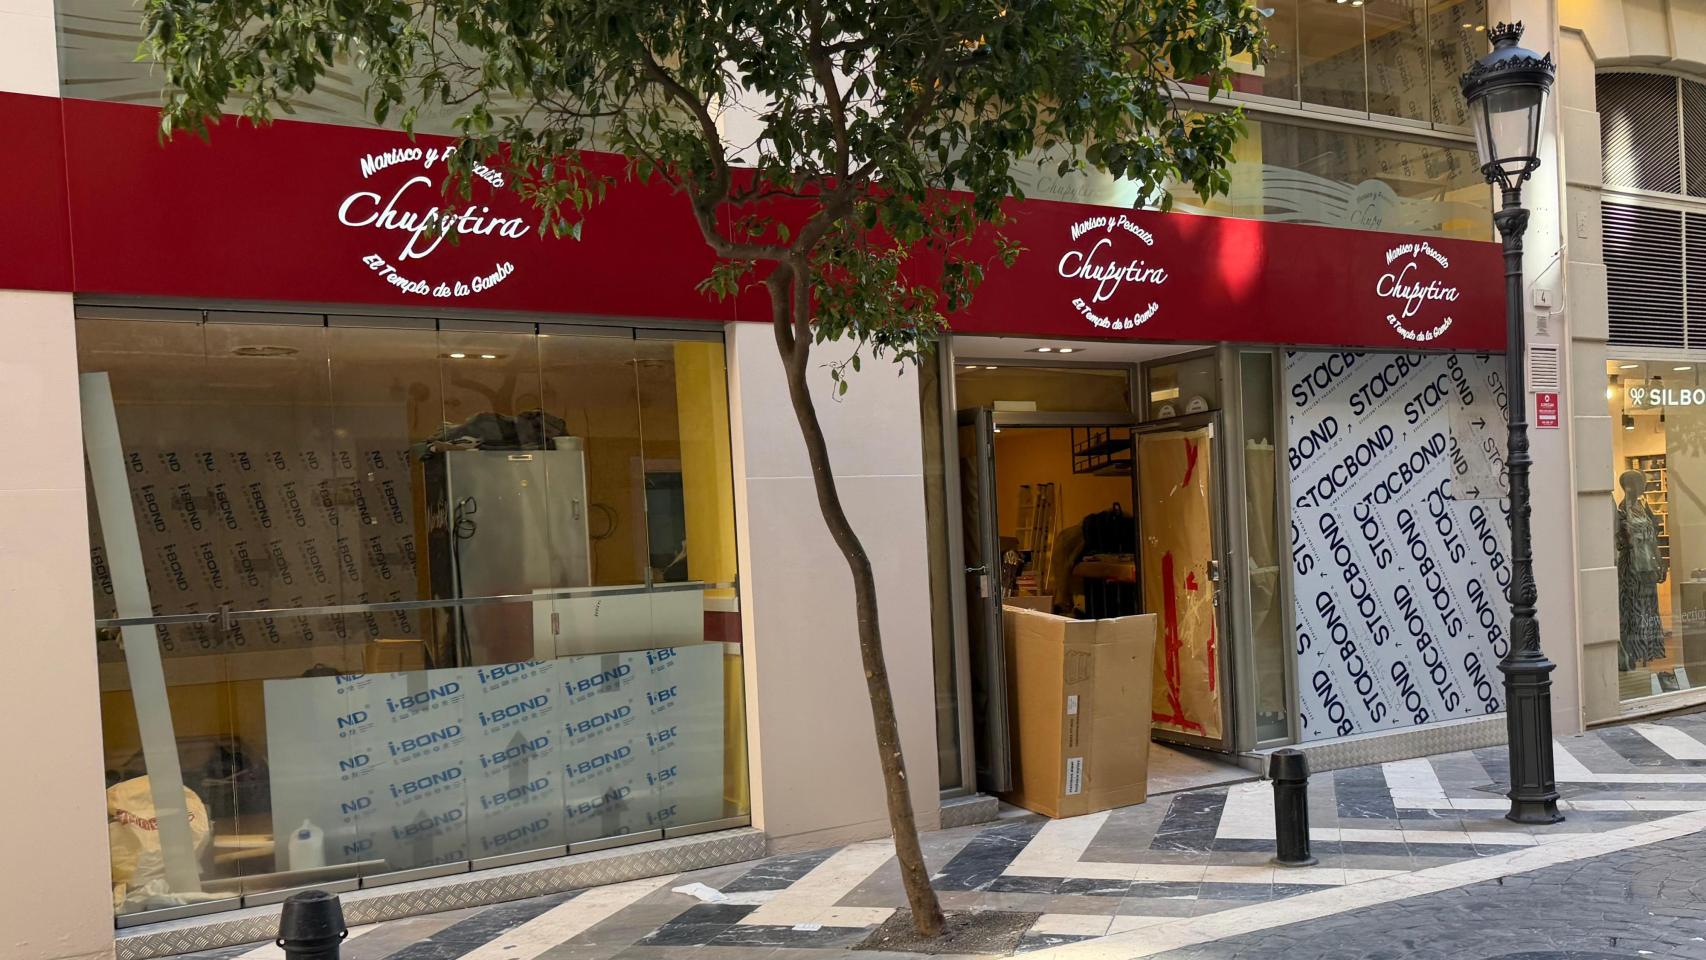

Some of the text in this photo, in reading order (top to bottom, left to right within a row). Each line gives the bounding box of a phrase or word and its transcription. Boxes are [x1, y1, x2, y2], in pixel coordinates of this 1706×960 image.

[361, 147, 422, 178] Marisco
[424, 147, 439, 168] y
[1070, 216, 1106, 241] Marisco
[1108, 216, 1116, 232] y
[1413, 243, 1420, 258] y
[362, 254, 514, 298] El Templo de la Gamba
[1058, 238, 1168, 303] Chupytira
[1376, 262, 1460, 319] Chupytira
[1071, 297, 1159, 330] El Templo de la Gamba
